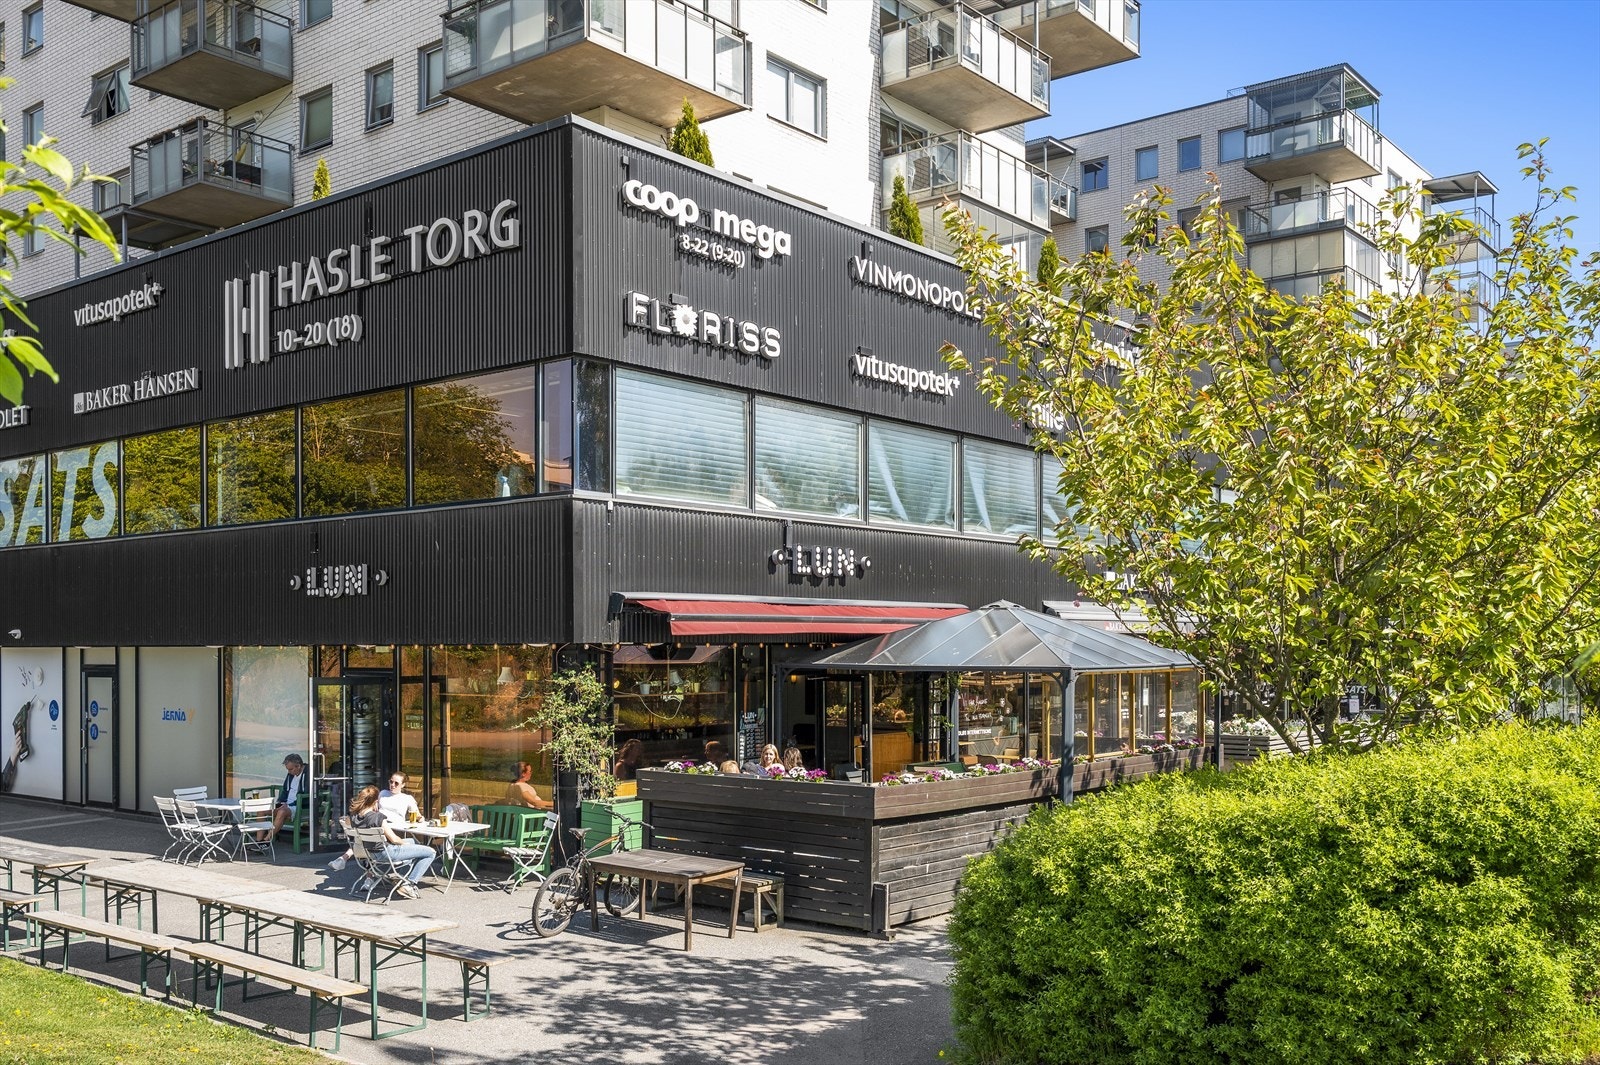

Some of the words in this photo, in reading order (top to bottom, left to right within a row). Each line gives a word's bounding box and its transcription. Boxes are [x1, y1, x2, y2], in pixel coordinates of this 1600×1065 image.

[623, 179, 699, 226] coop
[713, 208, 791, 259] mega
[278, 236, 391, 307] HASLE
[404, 199, 519, 273] TORG
[680, 234, 709, 256] 8-22
[712, 244, 746, 269] (9-20)
[853, 255, 984, 320] VINMONOPOLE
[327, 314, 363, 347] (18)
[86, 384, 131, 411] BAKER
[790, 543, 856, 577] LUN
[306, 563, 368, 599] LUN
